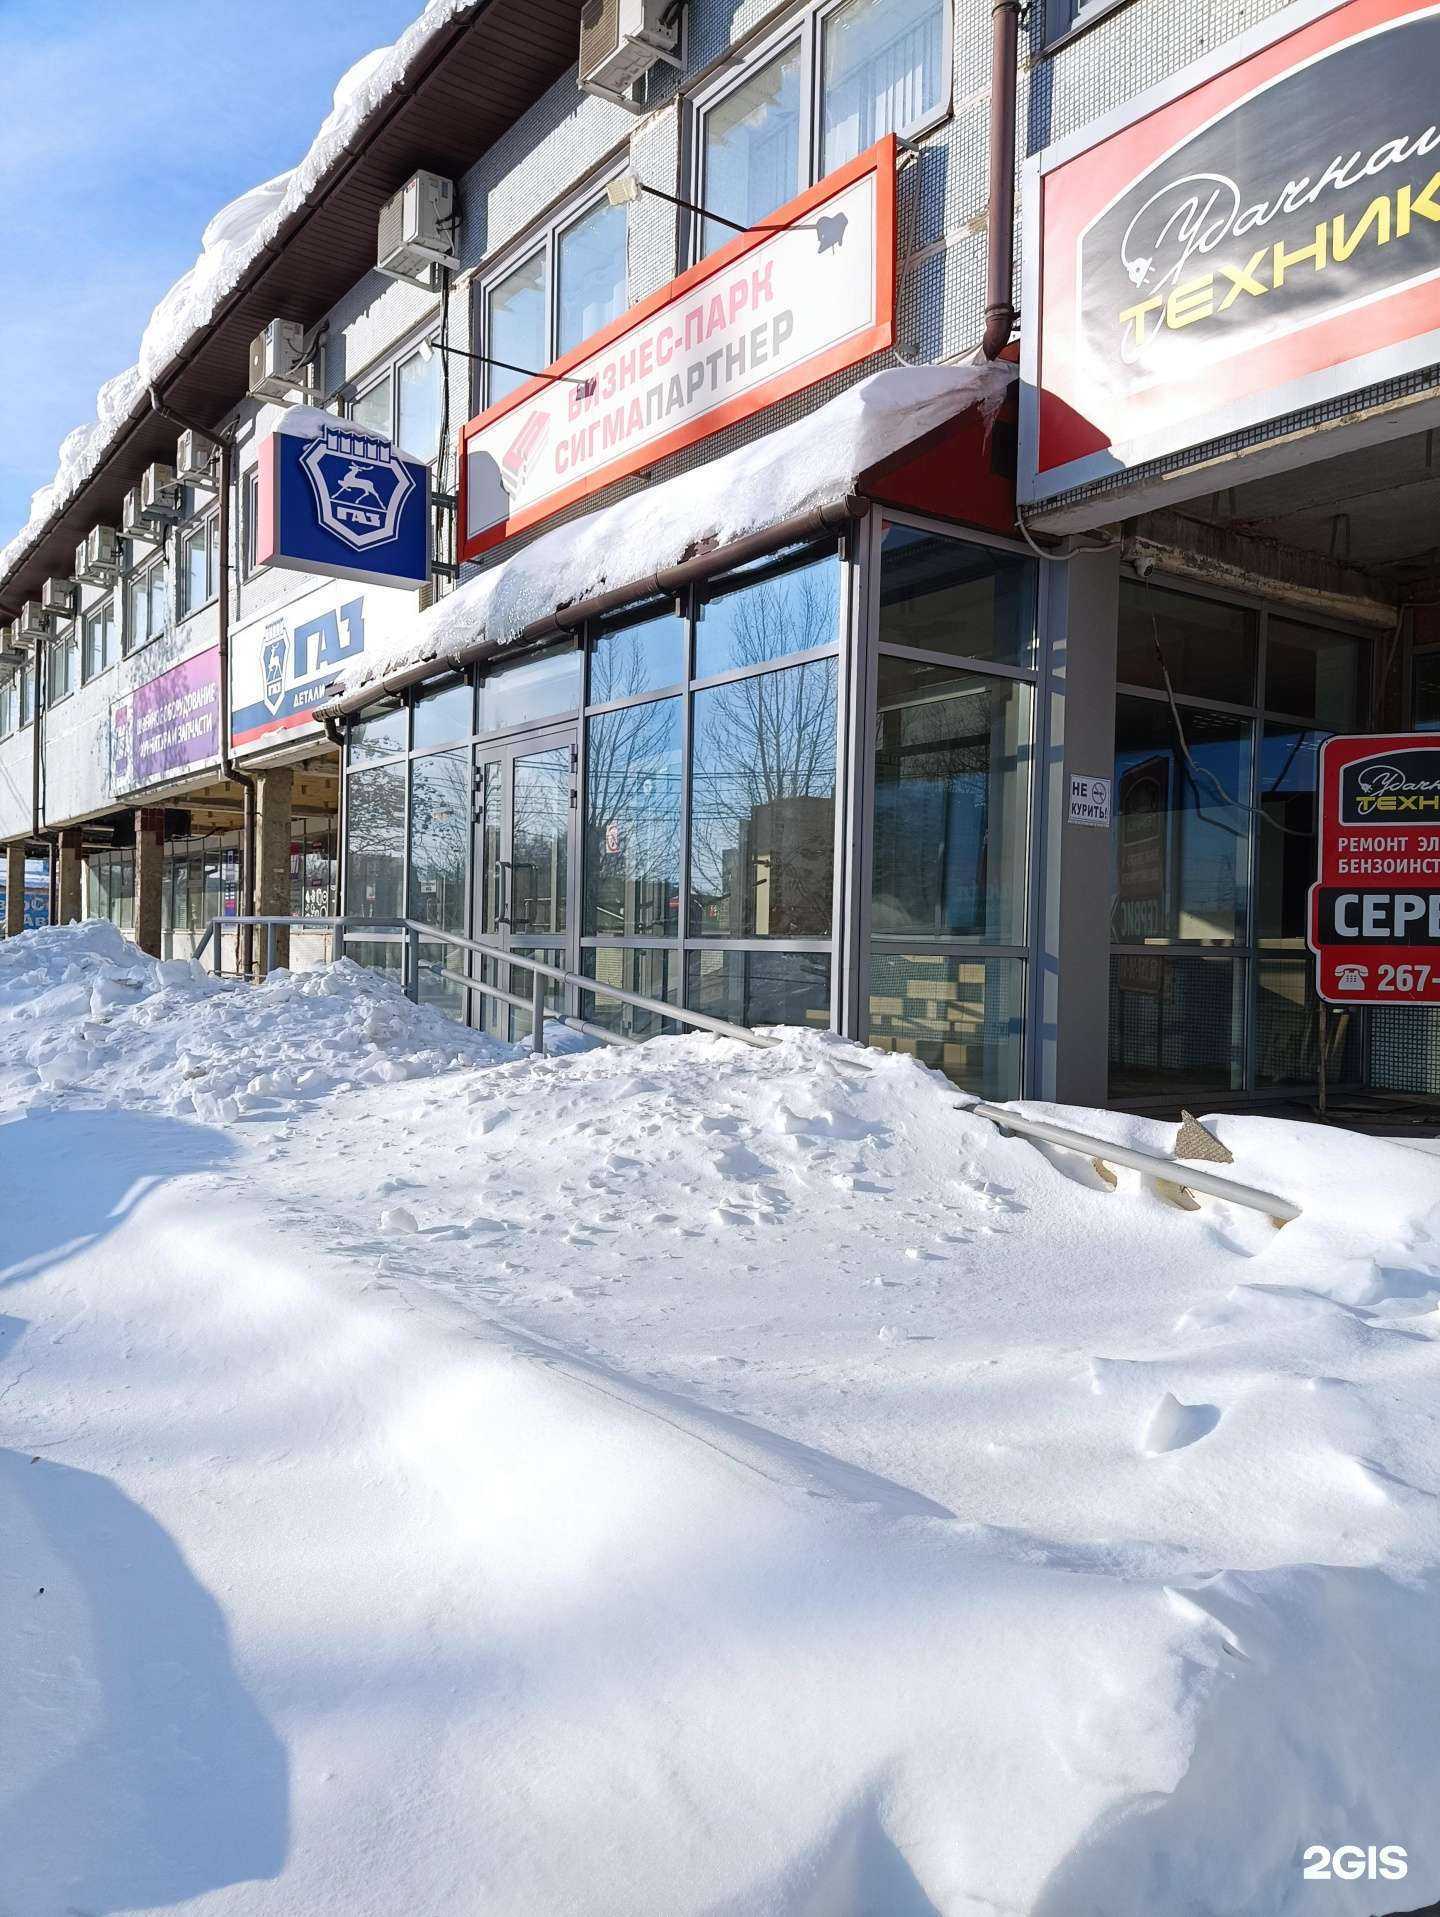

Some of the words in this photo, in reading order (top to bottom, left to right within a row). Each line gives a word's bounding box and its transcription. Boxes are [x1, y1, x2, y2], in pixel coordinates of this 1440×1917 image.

[568, 260, 774, 423] БИЗНЕС-ПАРК
[555, 309, 794, 474] СИГМАПАРТНЕР
[336, 506, 381, 527] ГАЗ
[294, 595, 364, 680] ГАЗ
[293, 683, 326, 707] ДЕТАЛИ
[1072, 782, 1088, 797] НЕ
[1071, 802, 1108, 819] КУРИТЬ!
[1338, 836, 1409, 852] РЕМОНТ
[1417, 836, 1440, 852] ЭЛ
[1338, 858, 1440, 874] БЕНЗОИНСТ
